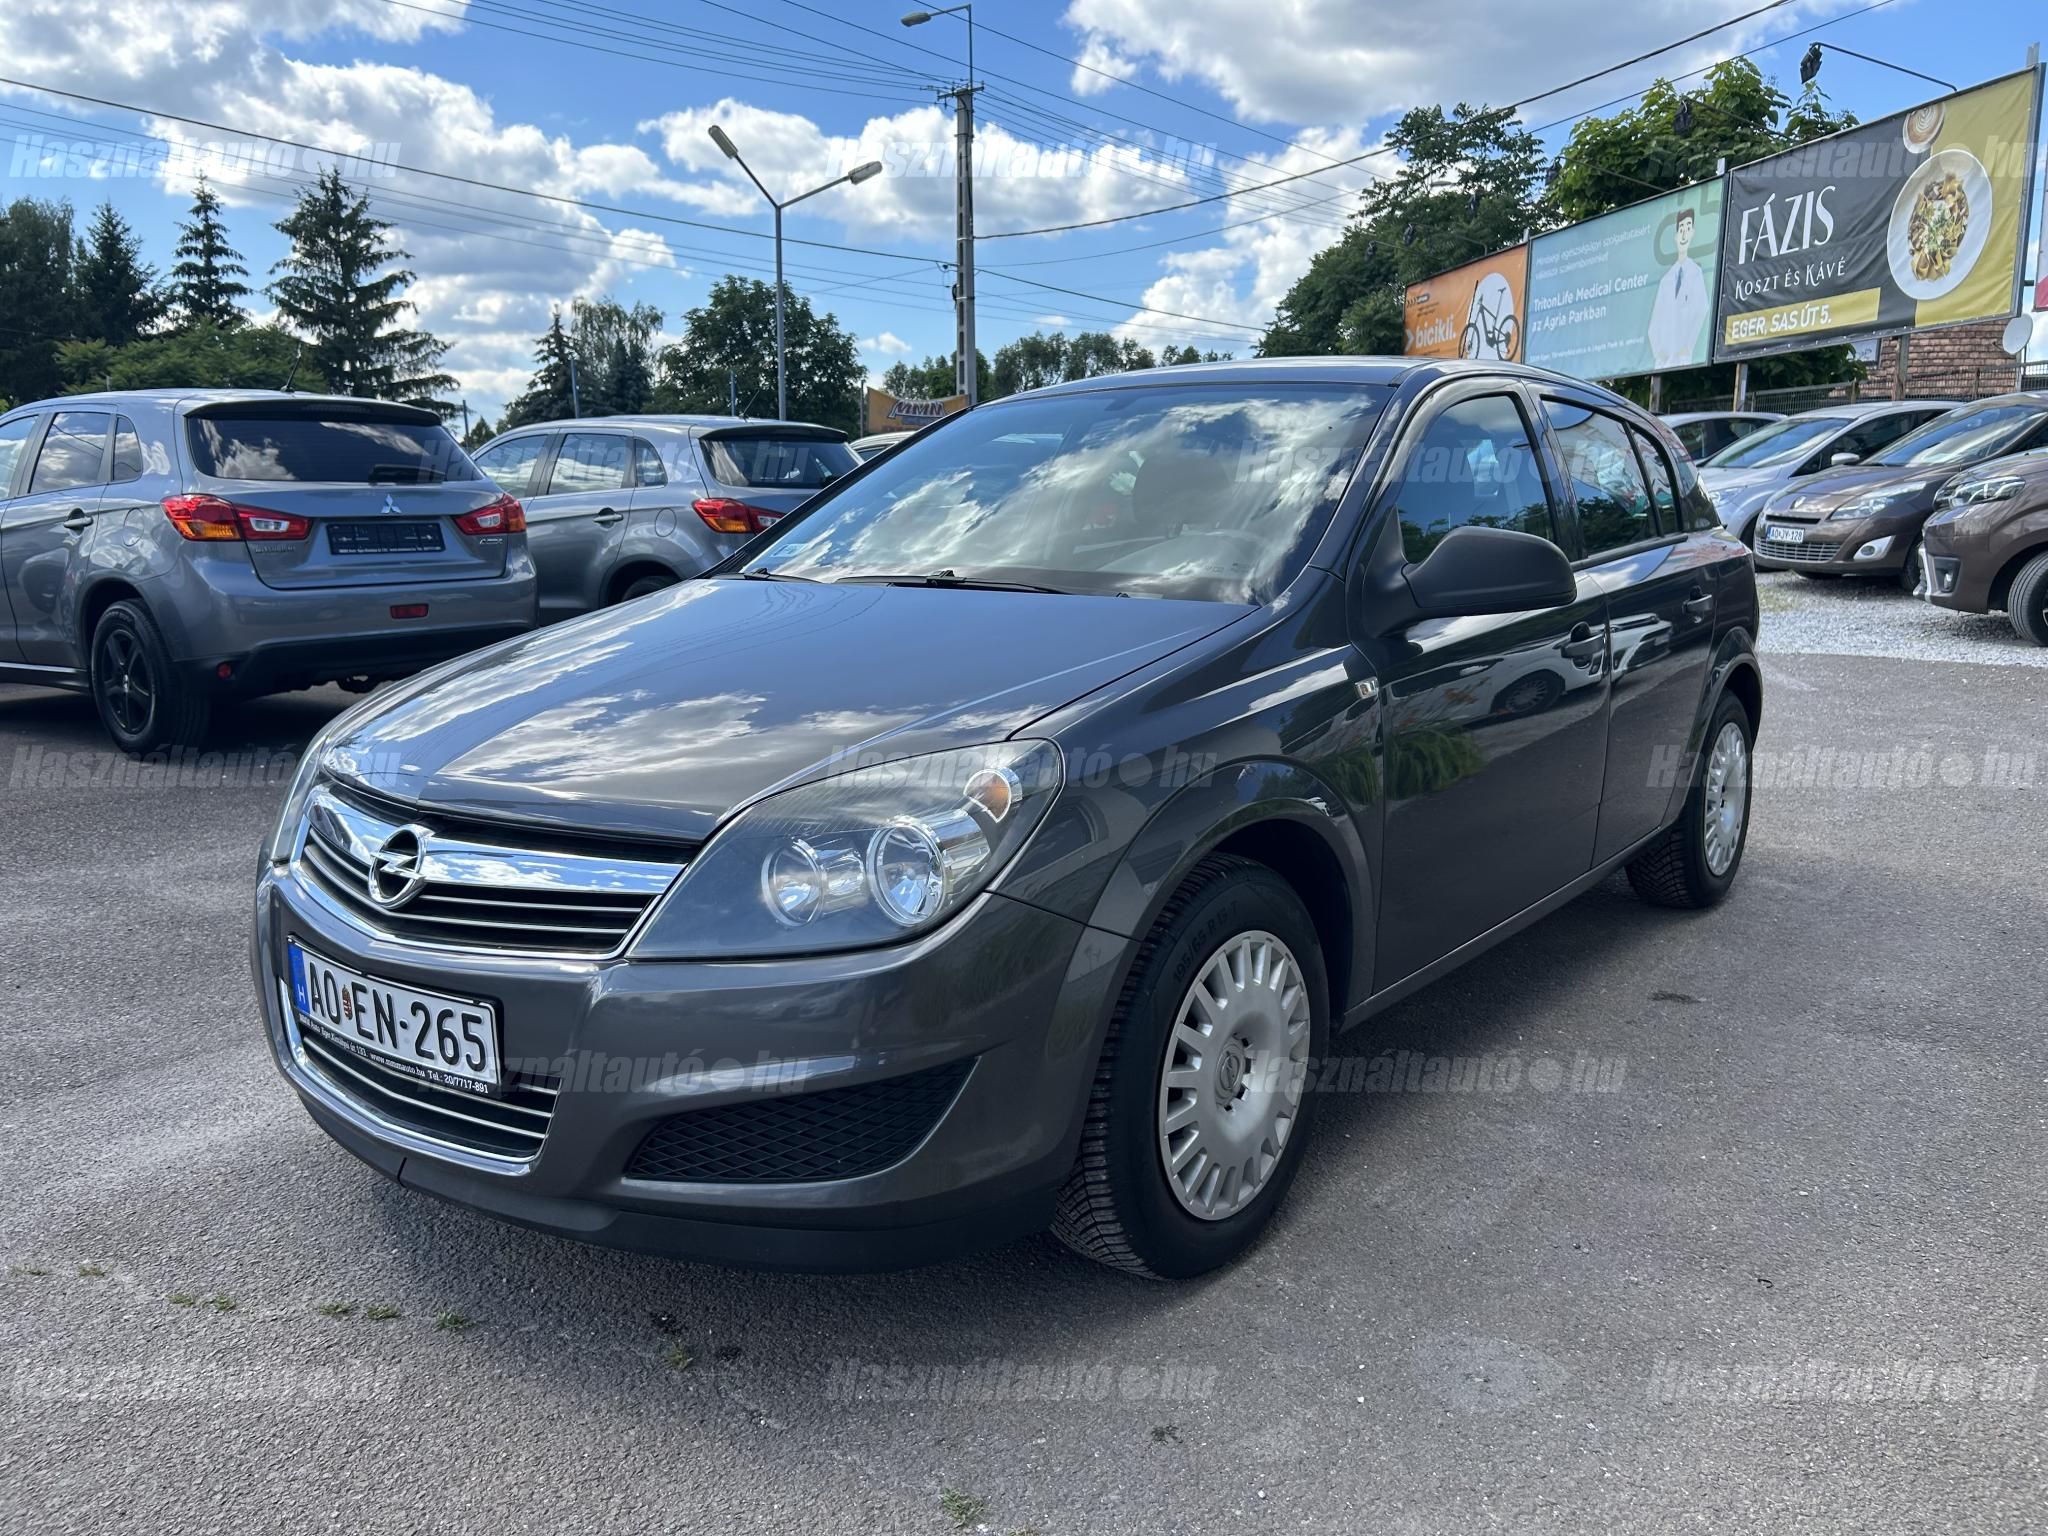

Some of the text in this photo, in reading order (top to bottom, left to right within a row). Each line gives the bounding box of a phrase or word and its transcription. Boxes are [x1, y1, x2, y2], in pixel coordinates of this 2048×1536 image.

[1738, 186, 1836, 265] FÁZIS
[1784, 268, 1800, 287] ÉS
[1805, 256, 1846, 287] KÁVÉ
[1534, 273, 1648, 312] TritonLife Medical Center
[1543, 313, 1566, 331] Agria
[1568, 306, 1607, 325] Parkban
[1731, 303, 1832, 340] EGER, SAS ÚT 5.
